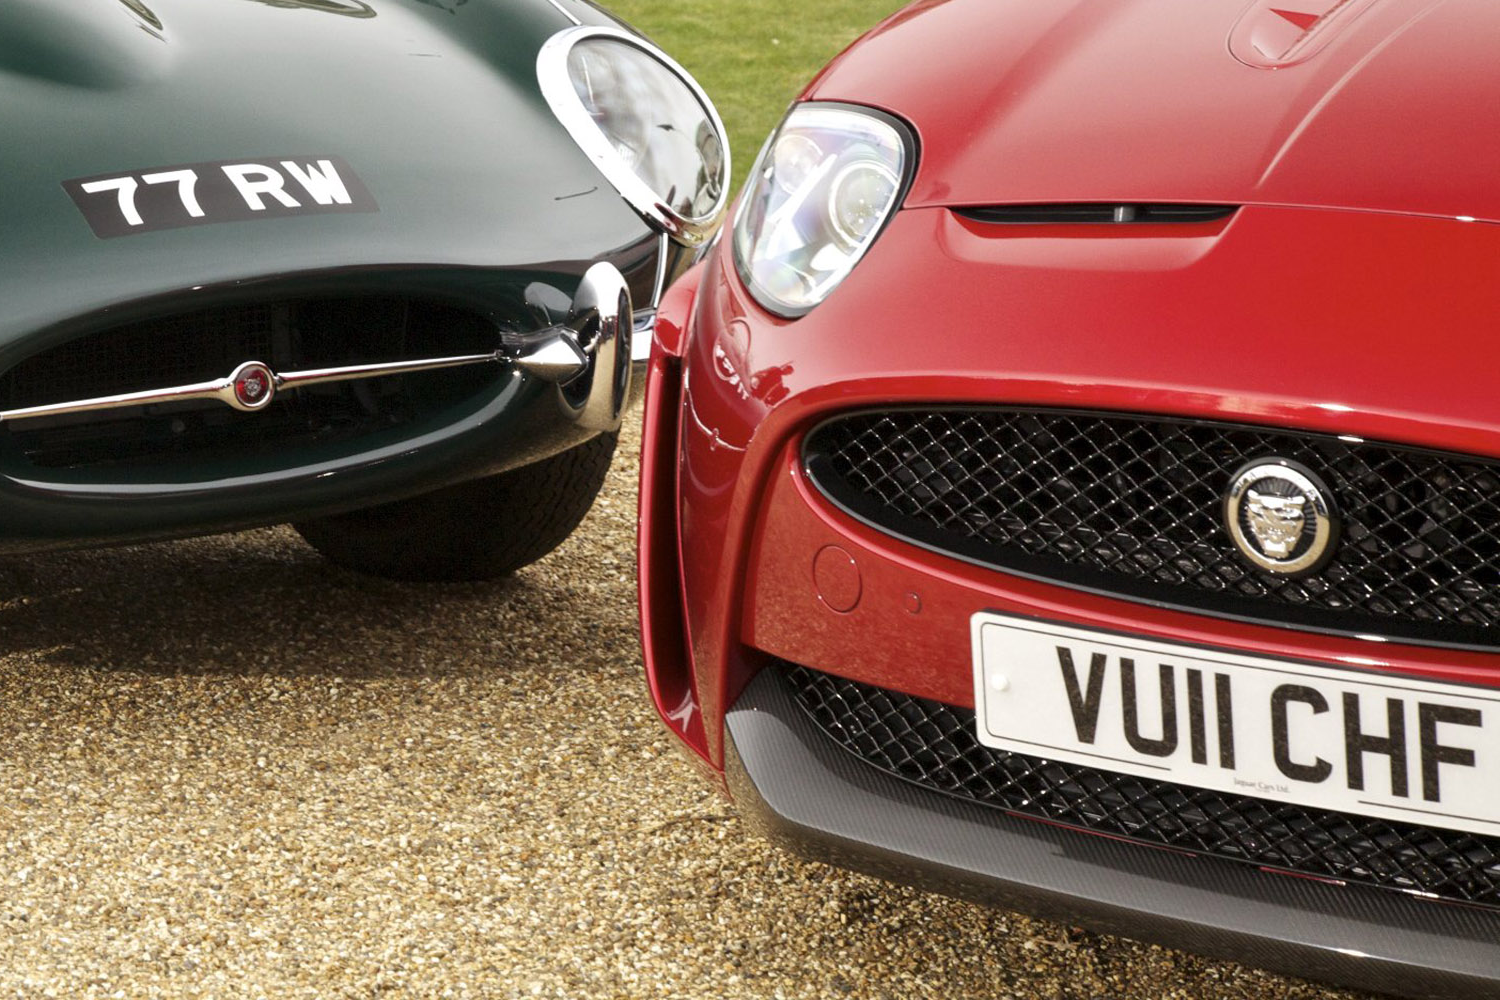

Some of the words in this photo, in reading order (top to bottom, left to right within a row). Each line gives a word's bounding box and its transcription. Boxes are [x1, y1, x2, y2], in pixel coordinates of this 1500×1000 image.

[81, 169, 205, 226] 77
[221, 159, 353, 211] RW
[1270, 683, 1483, 803] CHF
